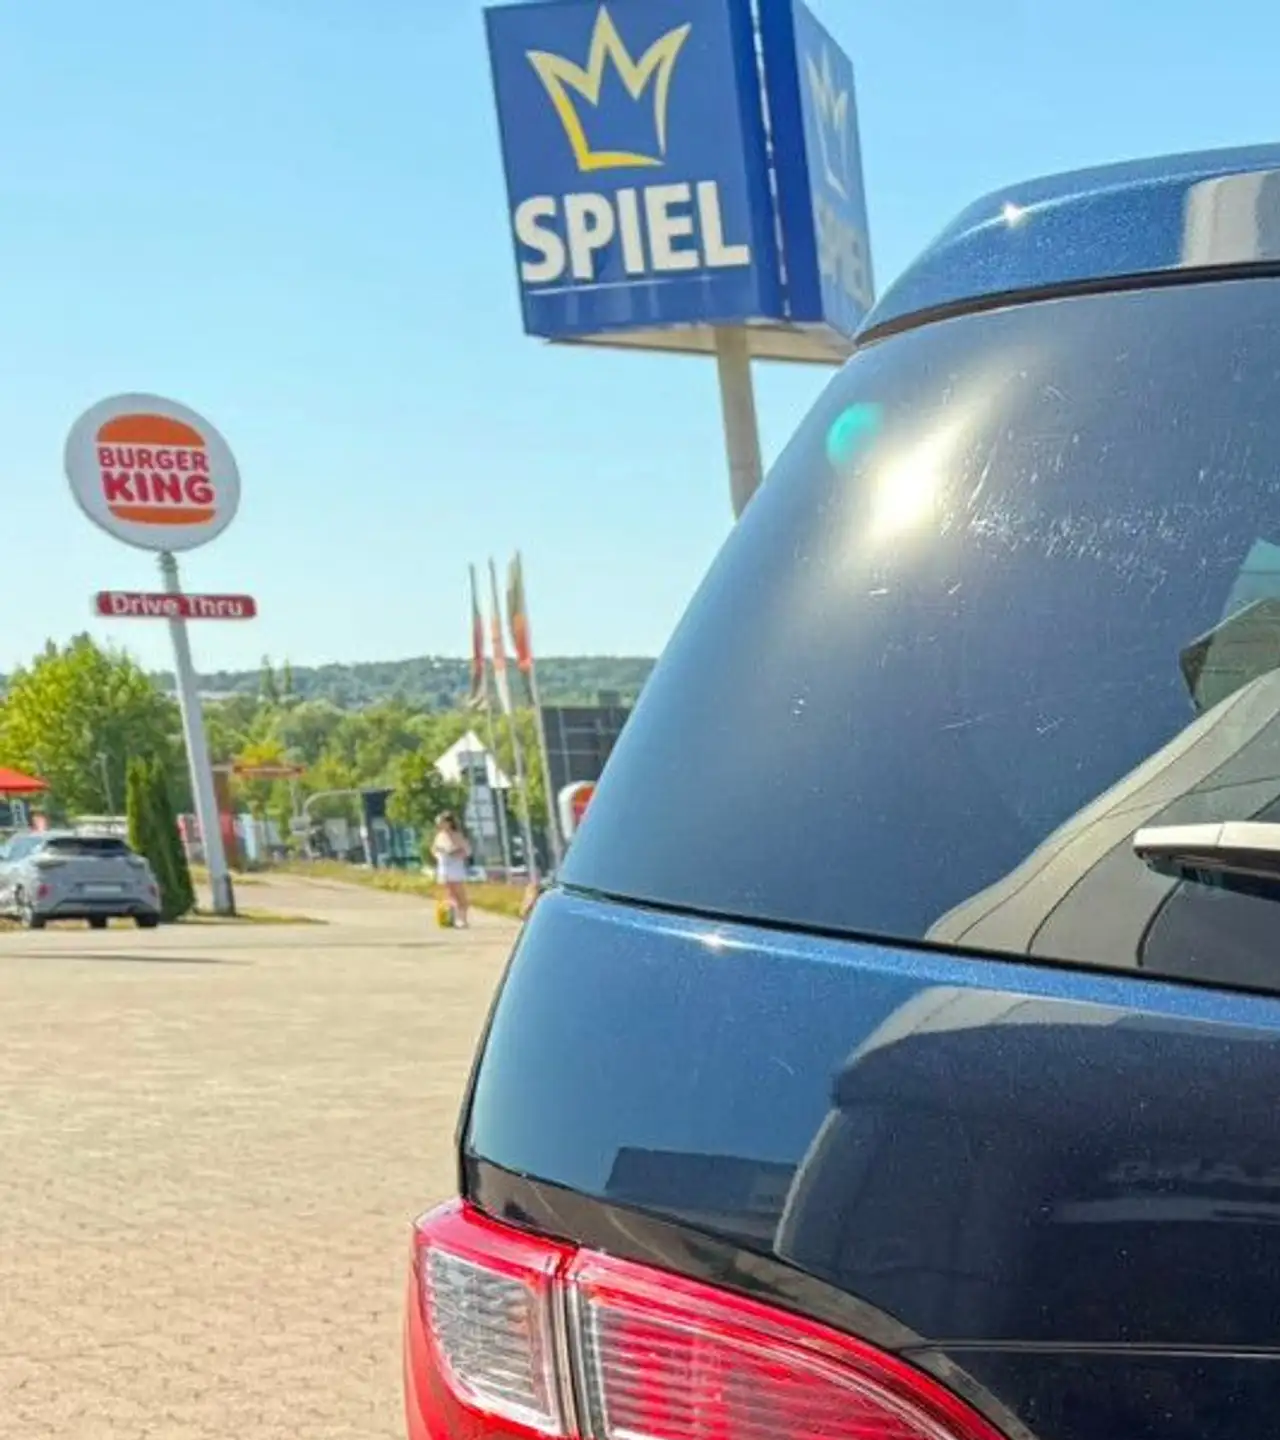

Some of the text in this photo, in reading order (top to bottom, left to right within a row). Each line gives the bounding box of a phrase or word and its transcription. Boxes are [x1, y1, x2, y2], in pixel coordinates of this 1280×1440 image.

[514, 180, 750, 283] SPIEL
[98, 447, 209, 472] BURGER
[102, 472, 214, 504] KING
[111, 594, 243, 616] Drive Thru
